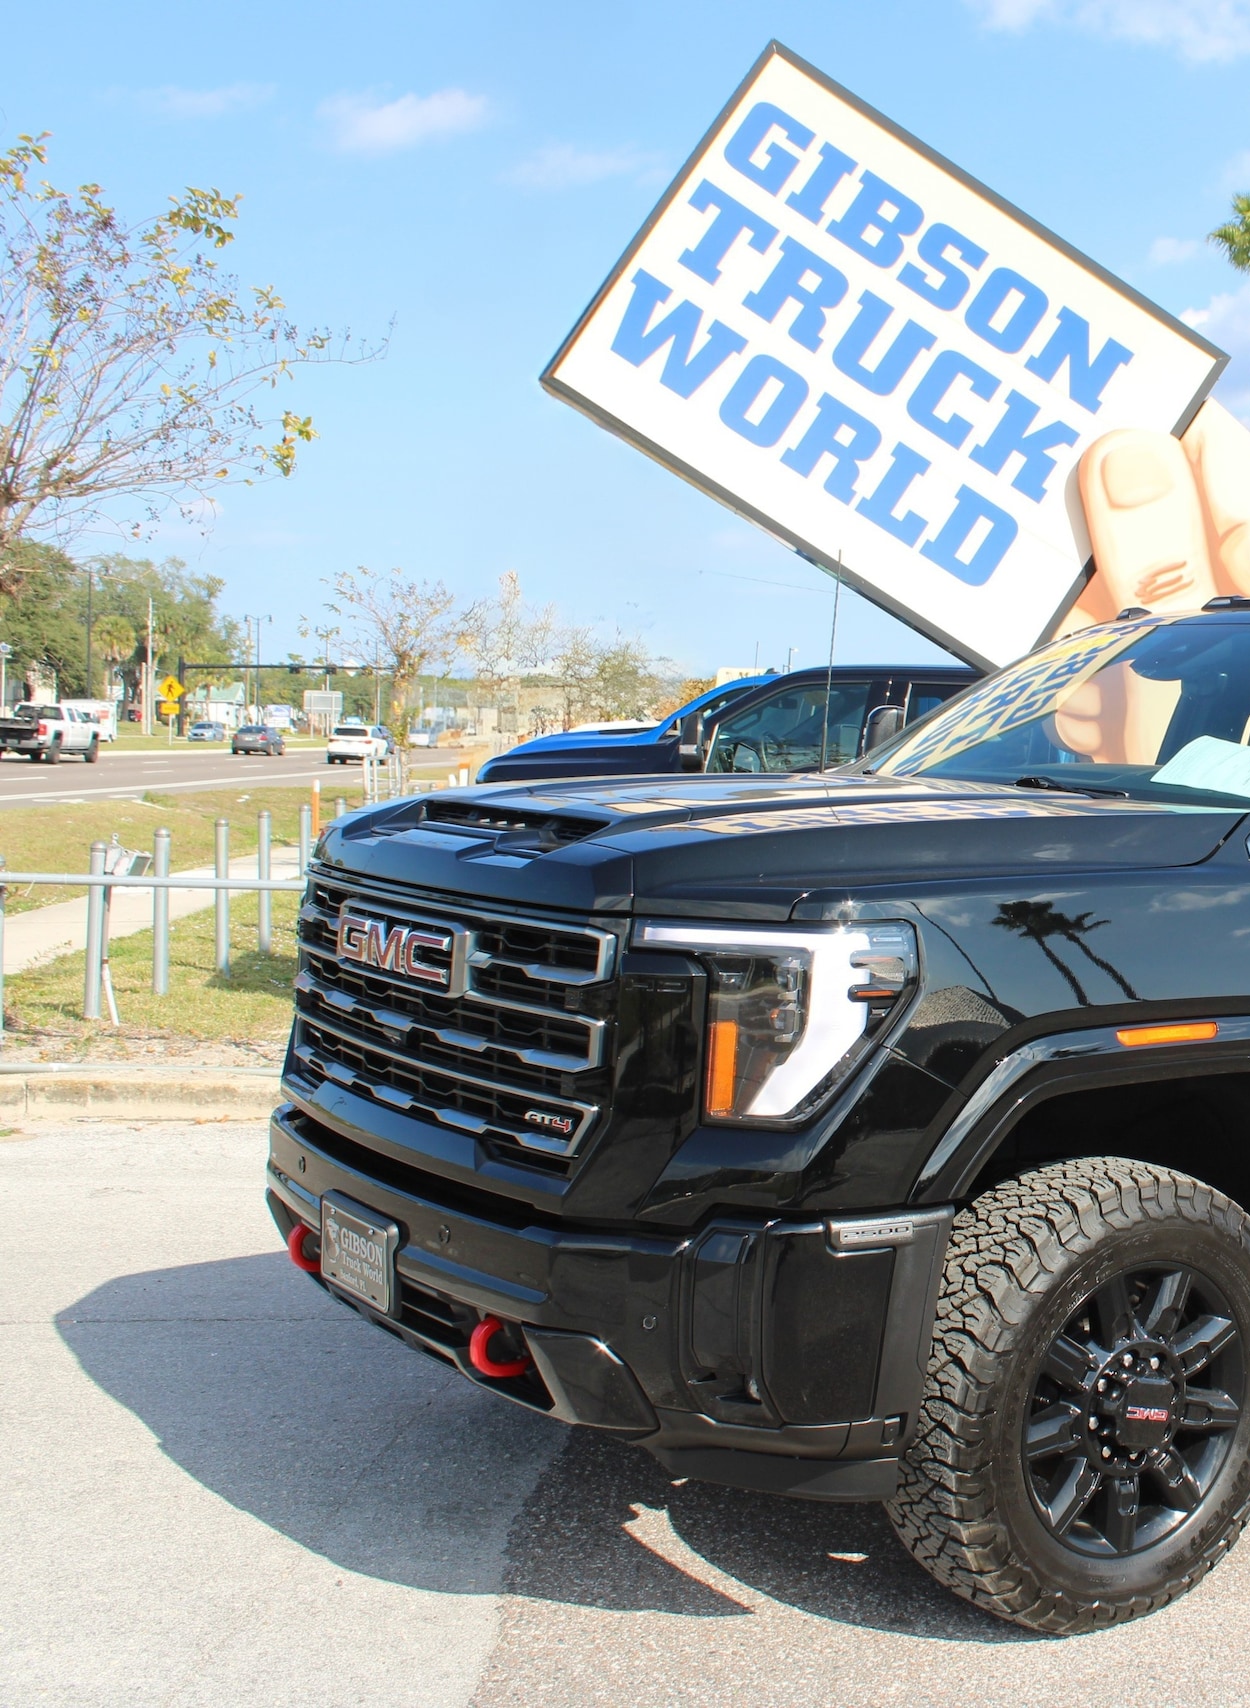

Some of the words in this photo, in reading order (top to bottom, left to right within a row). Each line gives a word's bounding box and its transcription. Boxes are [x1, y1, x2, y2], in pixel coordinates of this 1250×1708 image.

[723, 101, 1134, 414] GIBSON
[677, 178, 1080, 505] TRUCK
[610, 267, 1019, 587] WORLD
[340, 913, 451, 984] GMC
[524, 1110, 573, 1133] AT4
[341, 1227, 383, 1268] GIBSON
[843, 1226, 910, 1239] 2500
[341, 1251, 362, 1273] Truck
[363, 1261, 384, 1285] World
[1126, 1406, 1169, 1422] GMC
